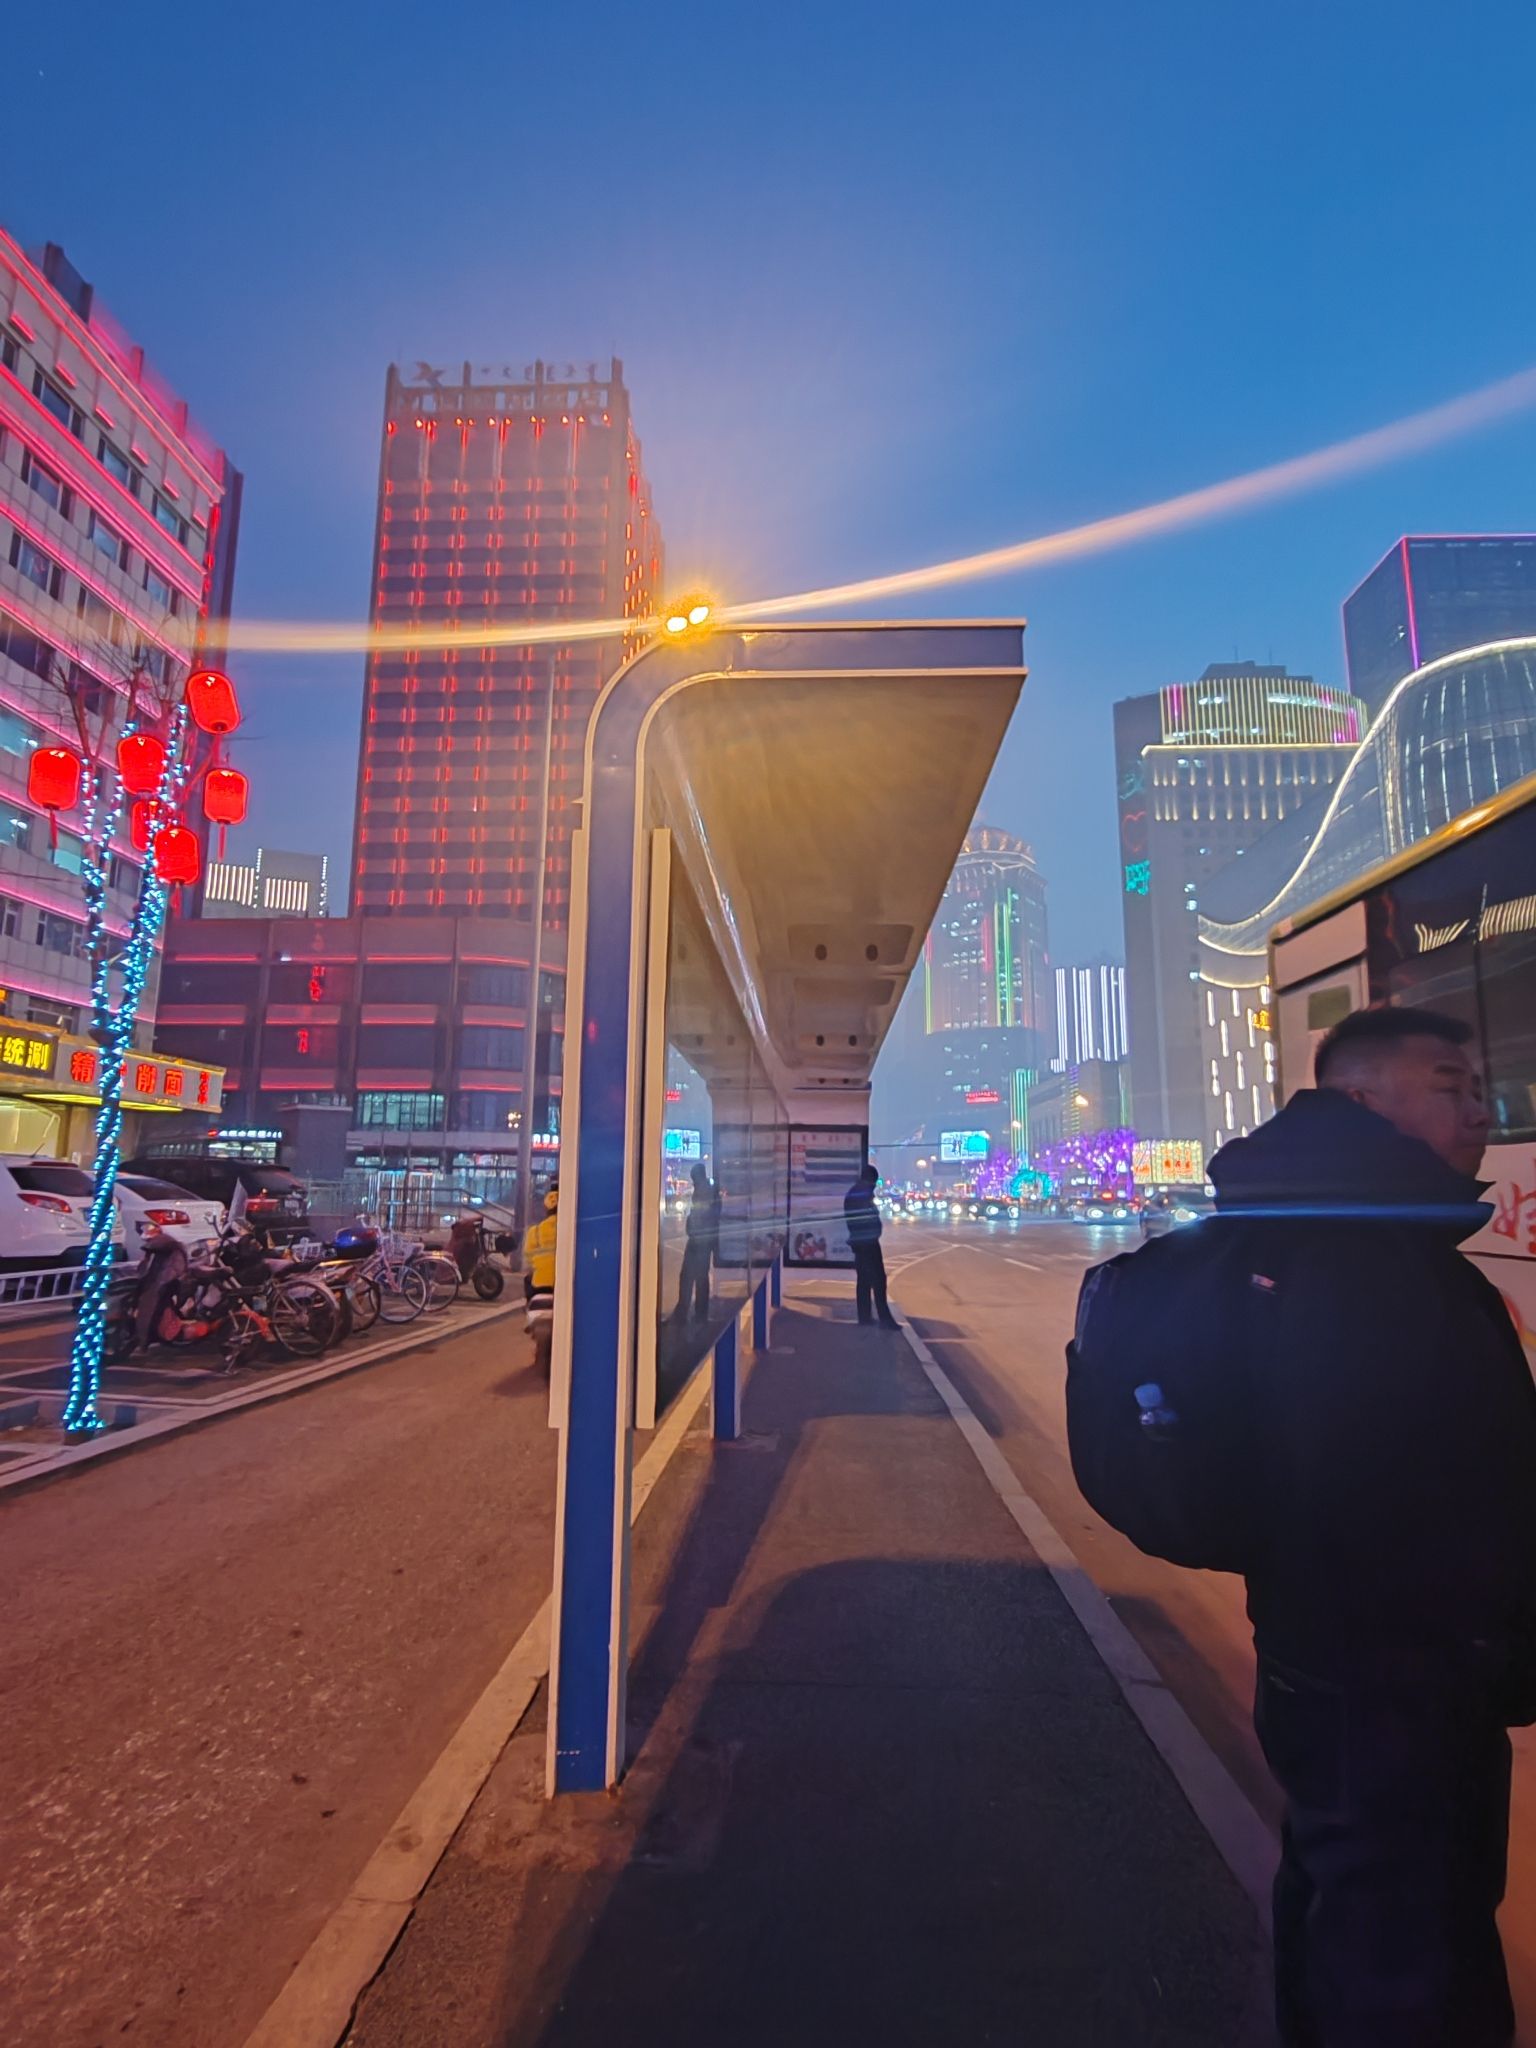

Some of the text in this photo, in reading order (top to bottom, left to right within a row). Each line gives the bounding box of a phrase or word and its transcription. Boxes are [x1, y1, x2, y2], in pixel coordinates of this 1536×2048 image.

[0, 1036, 49, 1071] 统涮
[71, 1051, 184, 1096] 精削面
